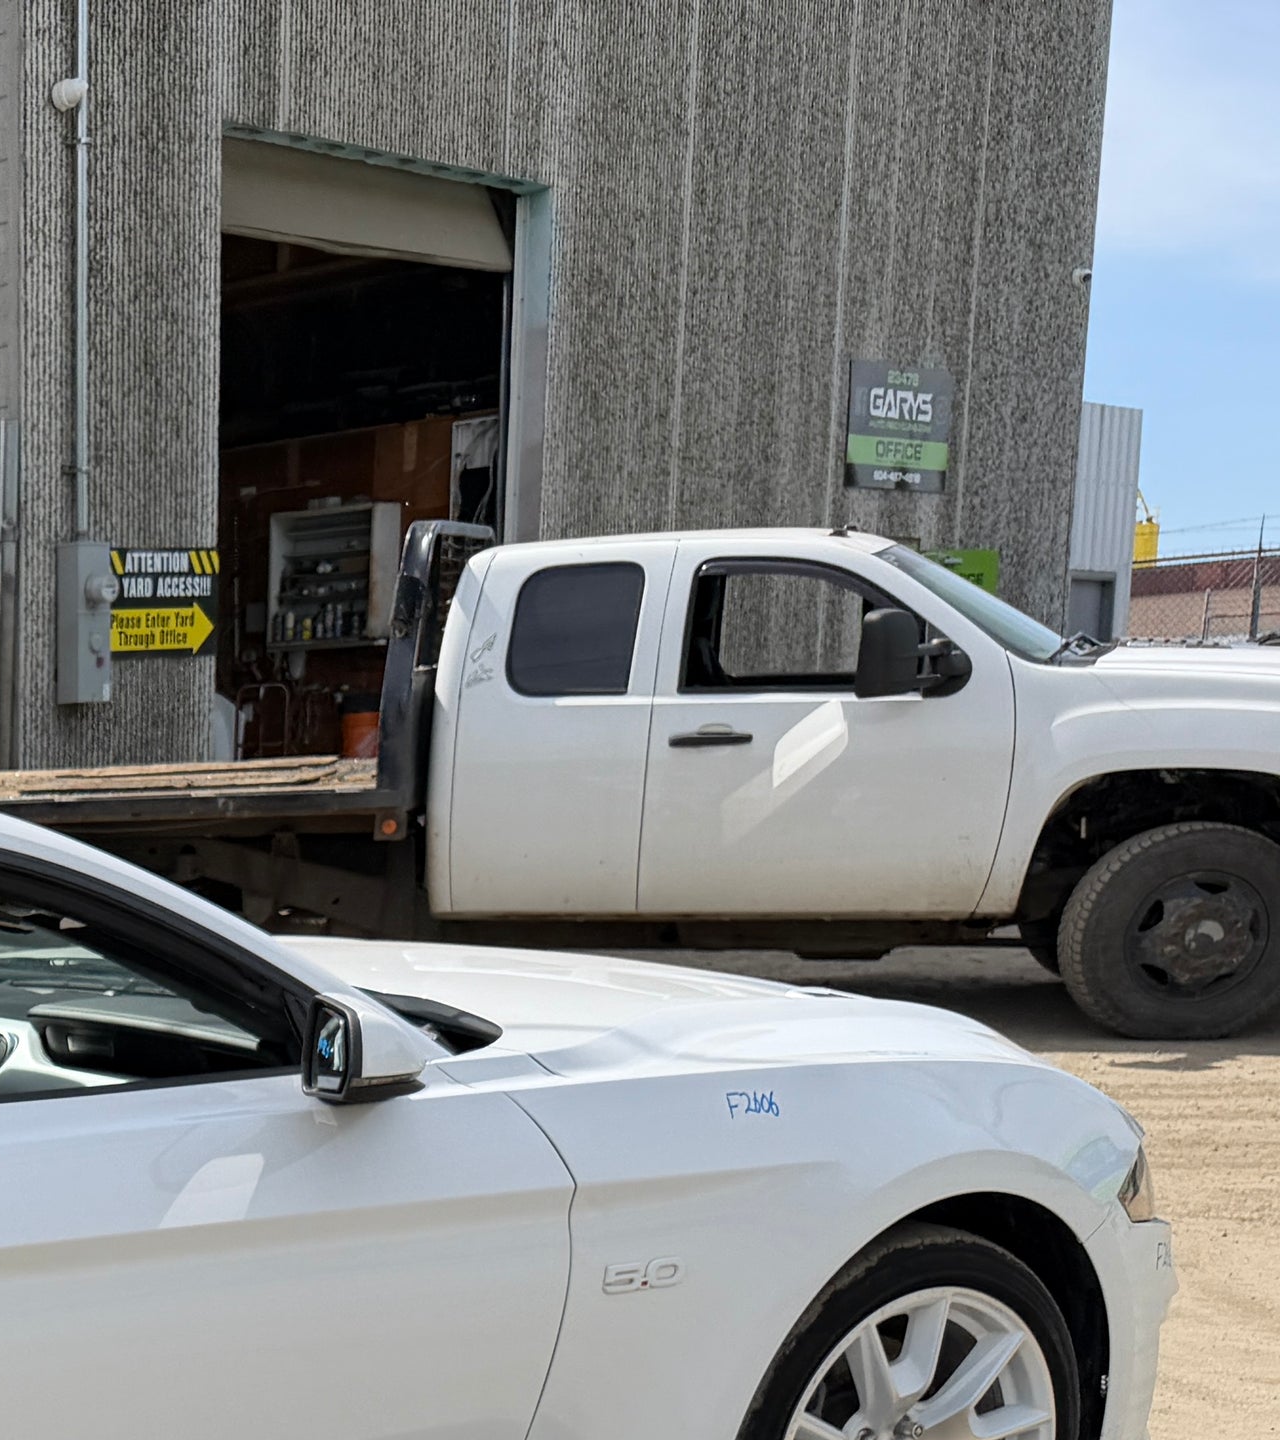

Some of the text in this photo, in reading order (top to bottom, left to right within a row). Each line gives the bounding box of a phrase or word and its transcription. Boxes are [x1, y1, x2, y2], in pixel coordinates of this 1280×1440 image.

[875, 440, 923, 462] OFFICE
[124, 551, 190, 574] ATTENTION
[121, 575, 212, 599] YARD ACCESS!!!
[110, 611, 196, 630] Please Enter Yard
[118, 630, 188, 648] Through Office
[726, 1091, 780, 1119] F2606
[602, 1256, 685, 1295] 5.0
